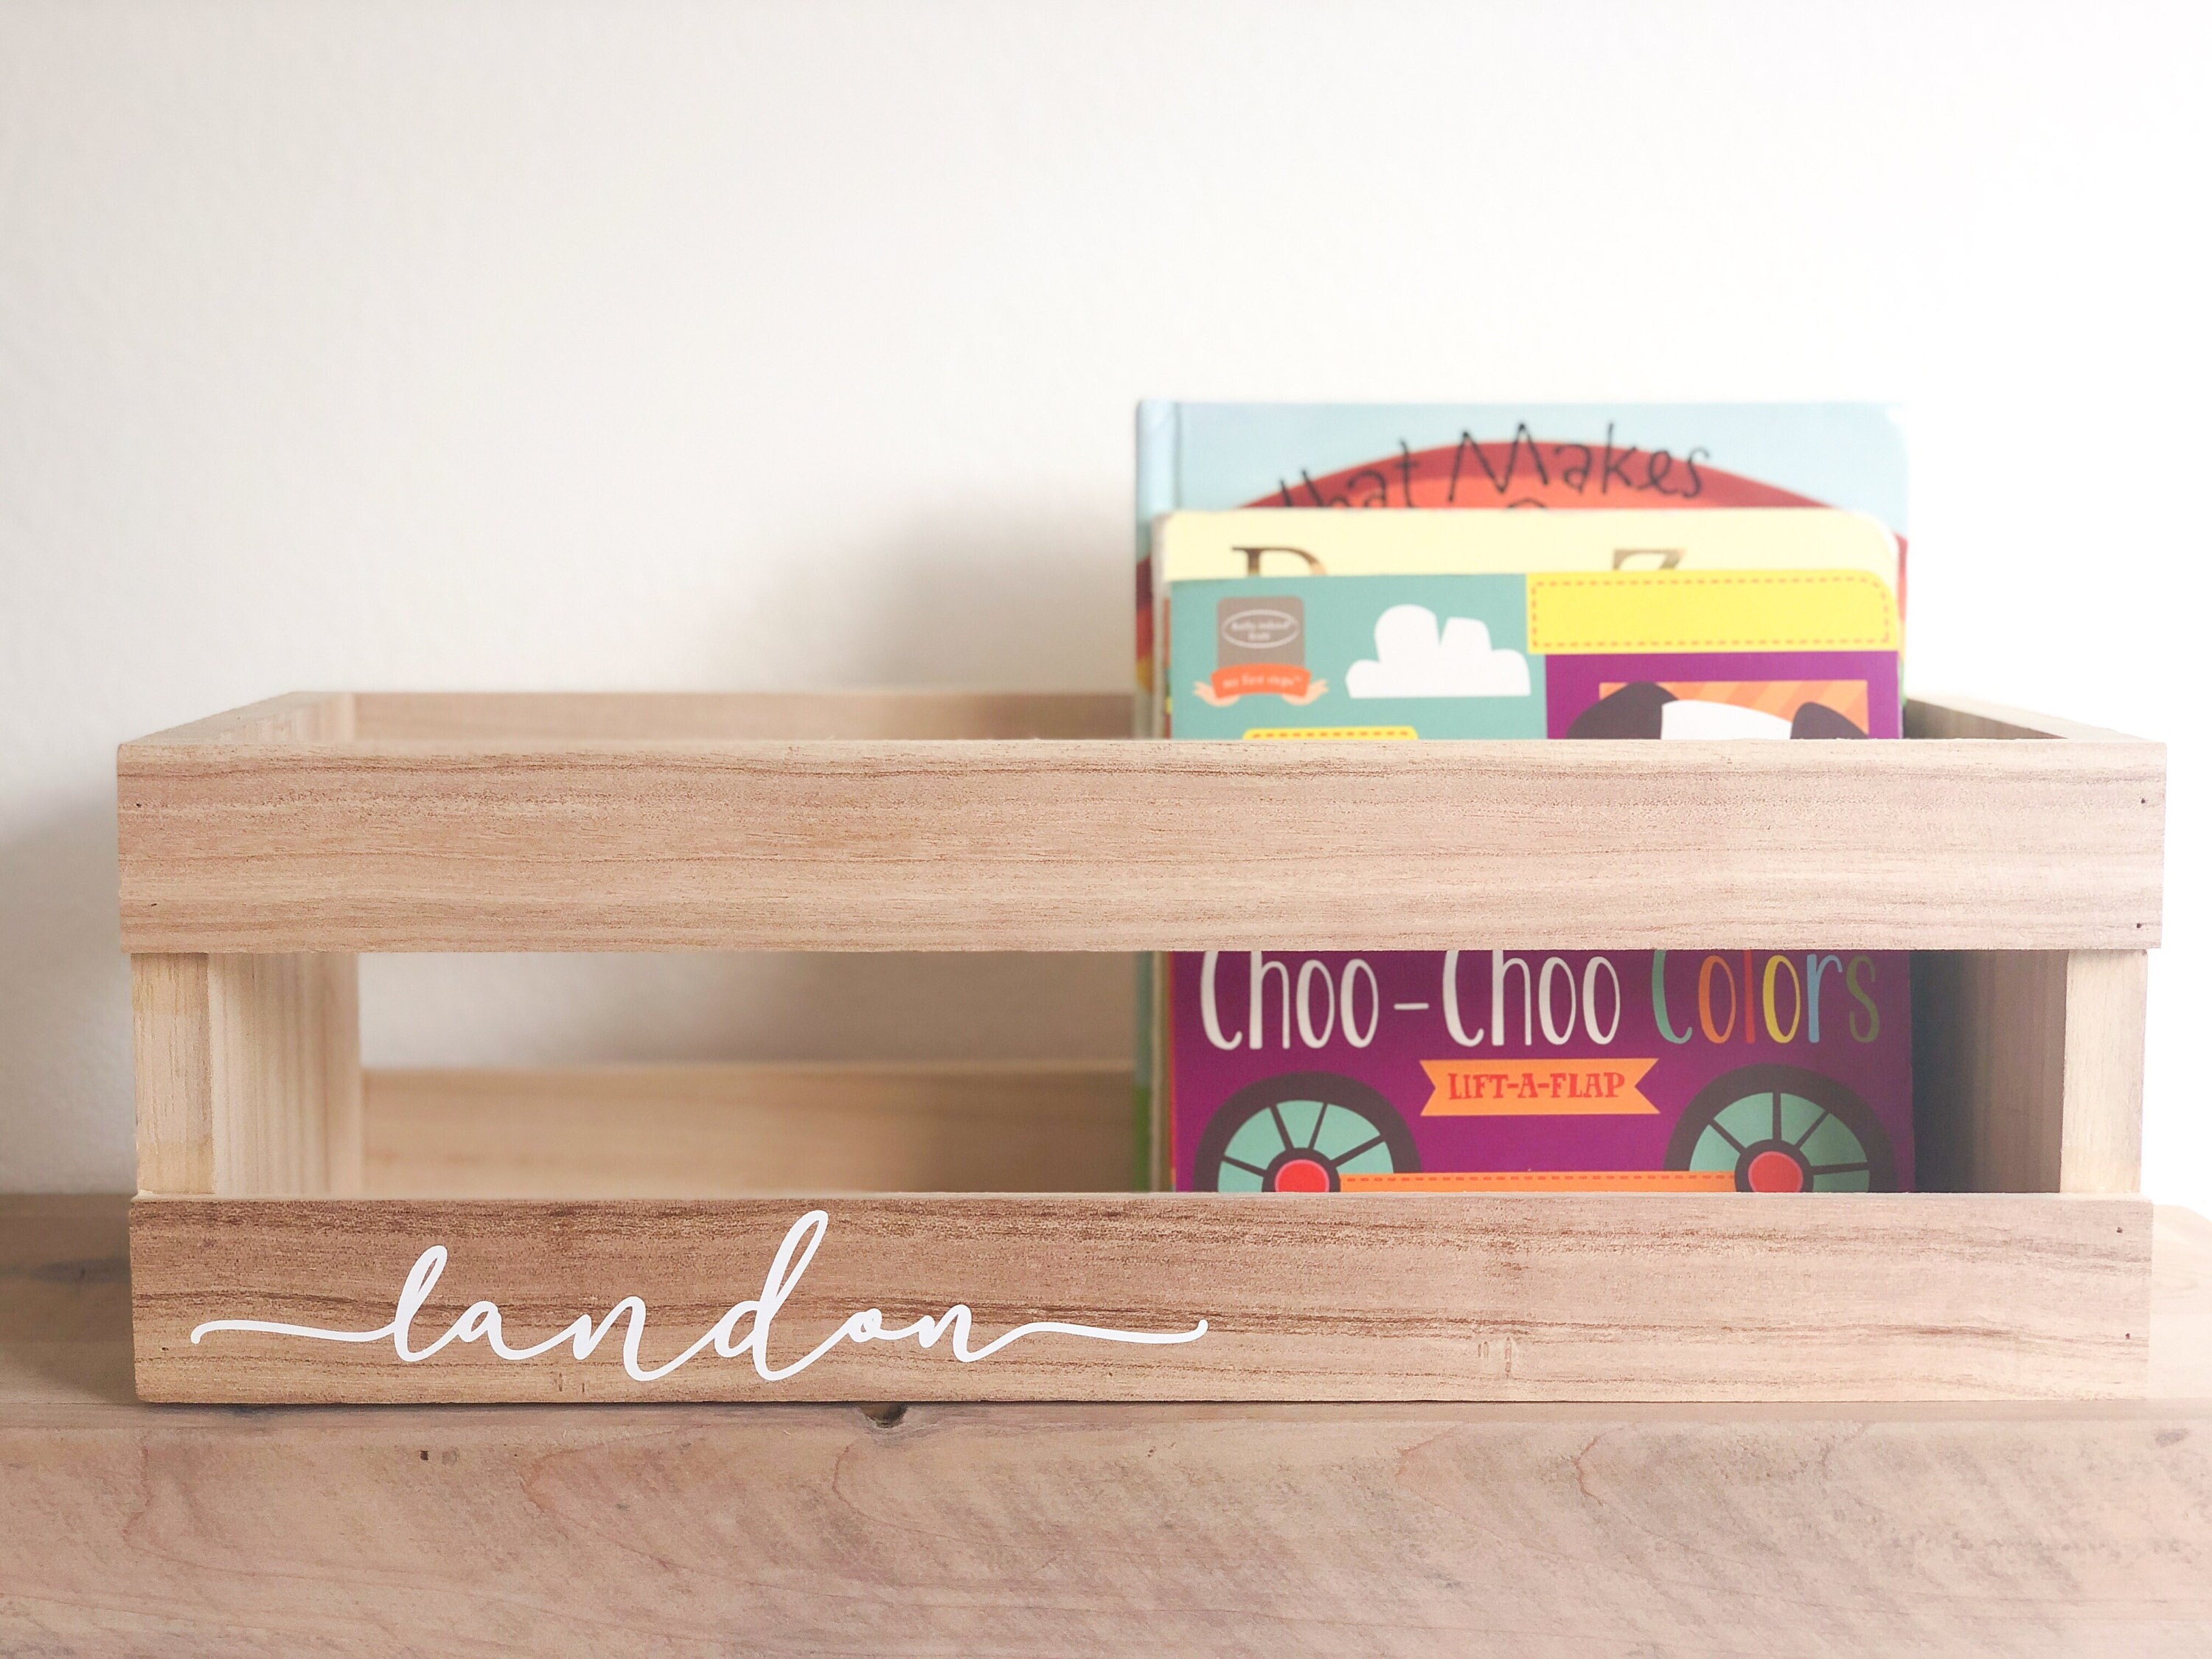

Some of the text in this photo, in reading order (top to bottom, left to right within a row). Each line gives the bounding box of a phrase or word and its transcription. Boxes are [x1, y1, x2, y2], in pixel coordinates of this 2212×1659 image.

[1279, 422, 1710, 508] hat Makes
[1652, 950, 1879, 1044] Colors
[1447, 1071, 1626, 1100] LIFT-A-FLAP
[190, 1210, 1208, 1382] landon
